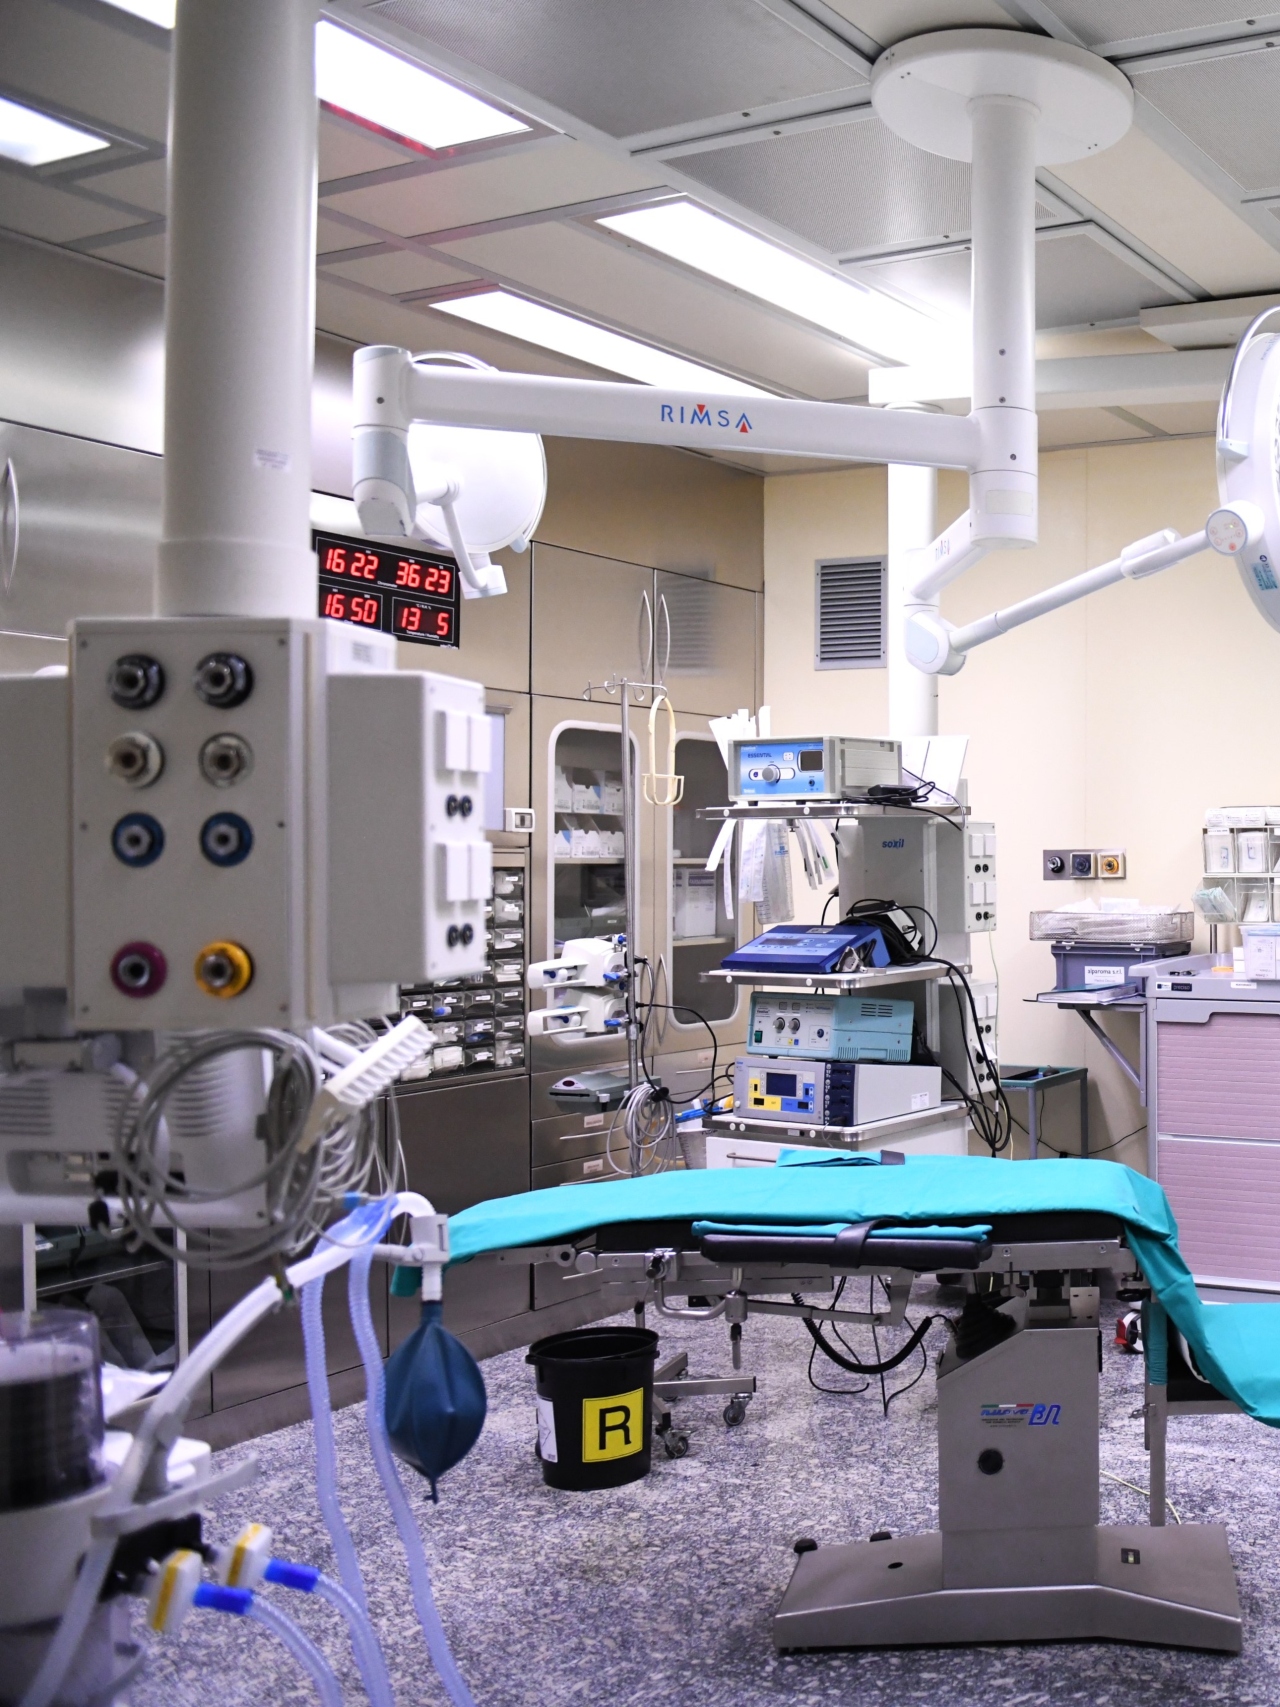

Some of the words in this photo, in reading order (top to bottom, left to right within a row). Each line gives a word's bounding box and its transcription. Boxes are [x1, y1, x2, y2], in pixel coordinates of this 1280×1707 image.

[661, 404, 753, 433] RIMSA
[326, 549, 346, 573] 16
[350, 552, 379, 579] 22
[395, 561, 421, 588] 36
[424, 568, 451, 593] 23
[325, 594, 345, 618] 16
[350, 597, 378, 623] 50
[401, 607, 421, 631] 13
[436, 612, 449, 635] 5
[598, 1405, 632, 1450] R
